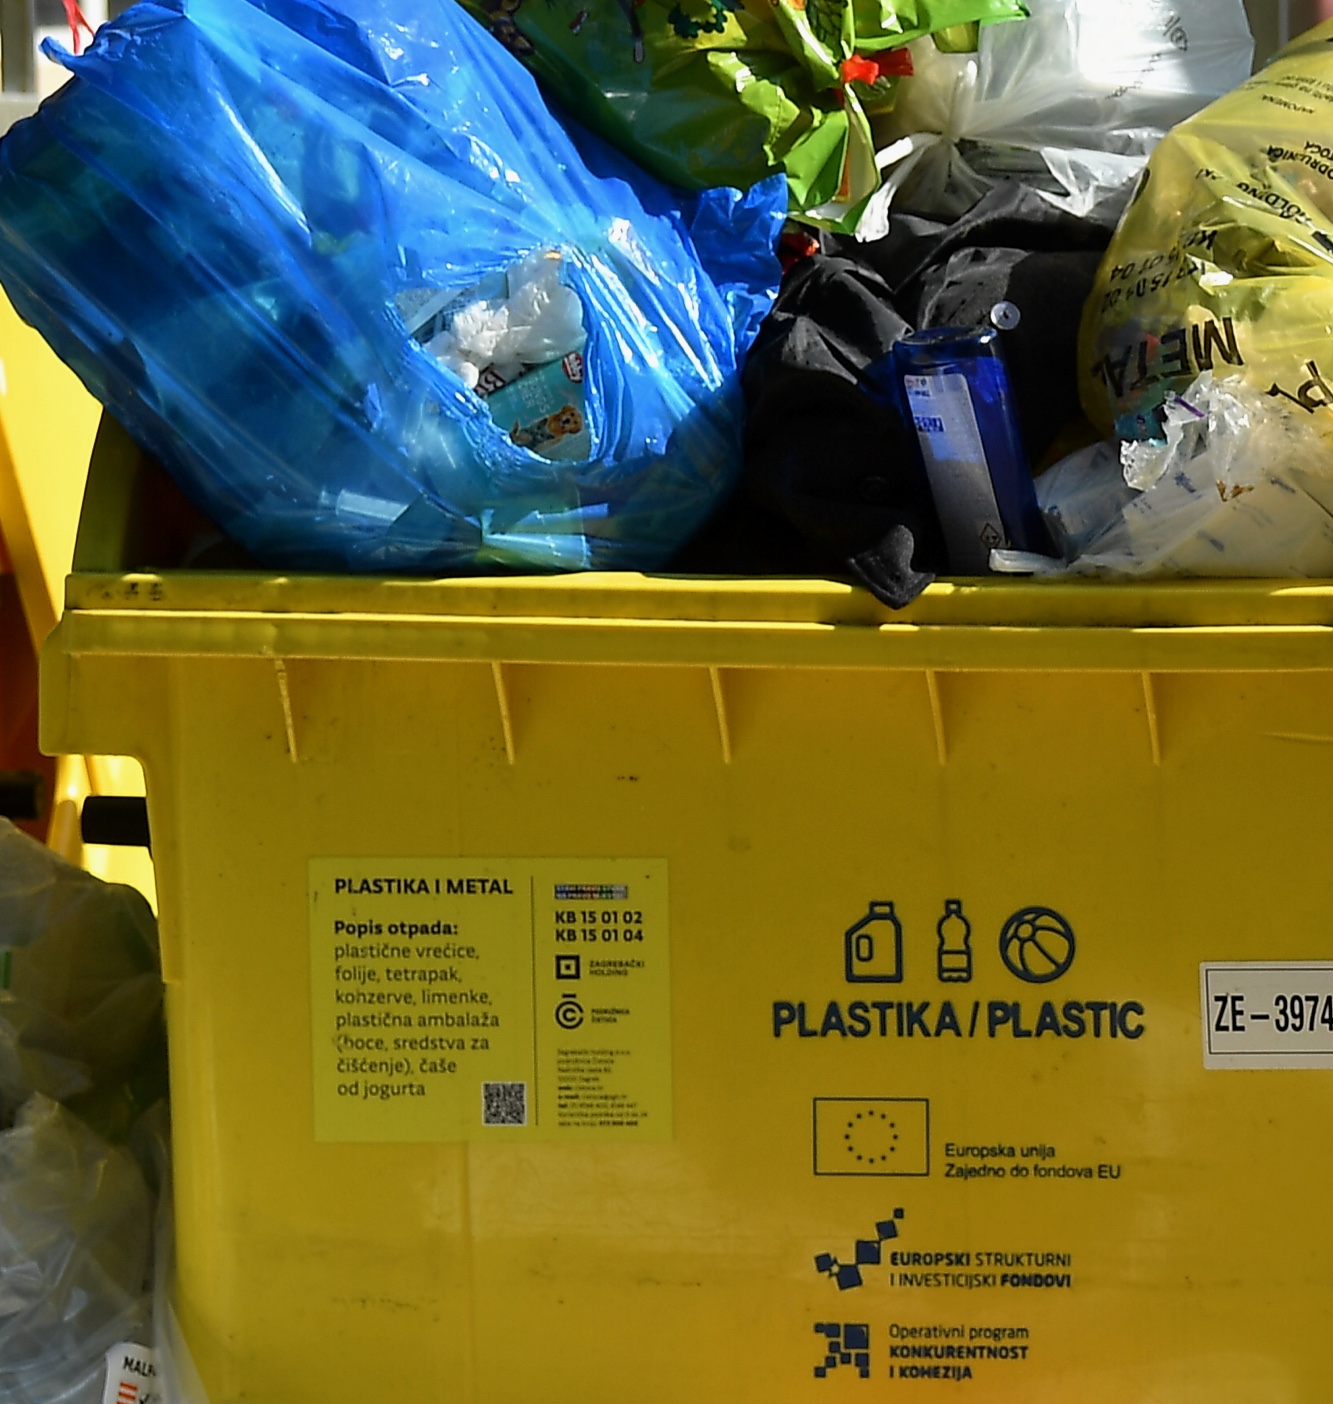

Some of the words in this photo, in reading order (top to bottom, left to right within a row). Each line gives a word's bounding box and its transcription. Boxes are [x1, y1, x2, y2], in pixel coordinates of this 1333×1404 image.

[335, 878, 430, 895] PLASTIKA
[447, 878, 513, 895] METAL
[555, 911, 577, 924] KB
[334, 919, 383, 939] Popis
[388, 920, 459, 940] otpada:
[555, 928, 577, 942] KB
[601, 928, 619, 942] 01
[623, 928, 644, 942] 04
[335, 943, 411, 962] plastične
[416, 942, 480, 960] vrećice,
[386, 966, 462, 986] tetrapak,
[422, 989, 493, 1007] limenke,
[336, 1011, 412, 1031] plastična
[417, 1011, 500, 1027] ambalaža
[773, 1001, 961, 1038] PLASTIKA
[987, 1001, 1145, 1039] PLASTIC
[393, 1035, 466, 1050] sredstva
[419, 1057, 457, 1073] čaše
[337, 1080, 359, 1096] od
[364, 1080, 426, 1100] jogurta
[945, 1142, 1016, 1160] Europska
[1020, 1143, 1055, 1160] unija
[945, 1163, 1006, 1181] Zajedno
[1010, 1163, 1030, 1179] do
[1033, 1163, 1095, 1179] fondova
[1098, 1164, 1121, 1180] EU
[890, 1252, 970, 1267] EUROPSKI
[975, 1252, 1071, 1267] STRUKTURNI
[899, 1273, 997, 1289] INVESTICIJSKI
[1001, 1273, 1072, 1287] FONDOVI
[889, 1323, 966, 1340] Operativni
[969, 1326, 1029, 1341] program
[889, 1345, 1028, 1360] KONKURENTNOST
[899, 1366, 973, 1381] KOHEZIJA
